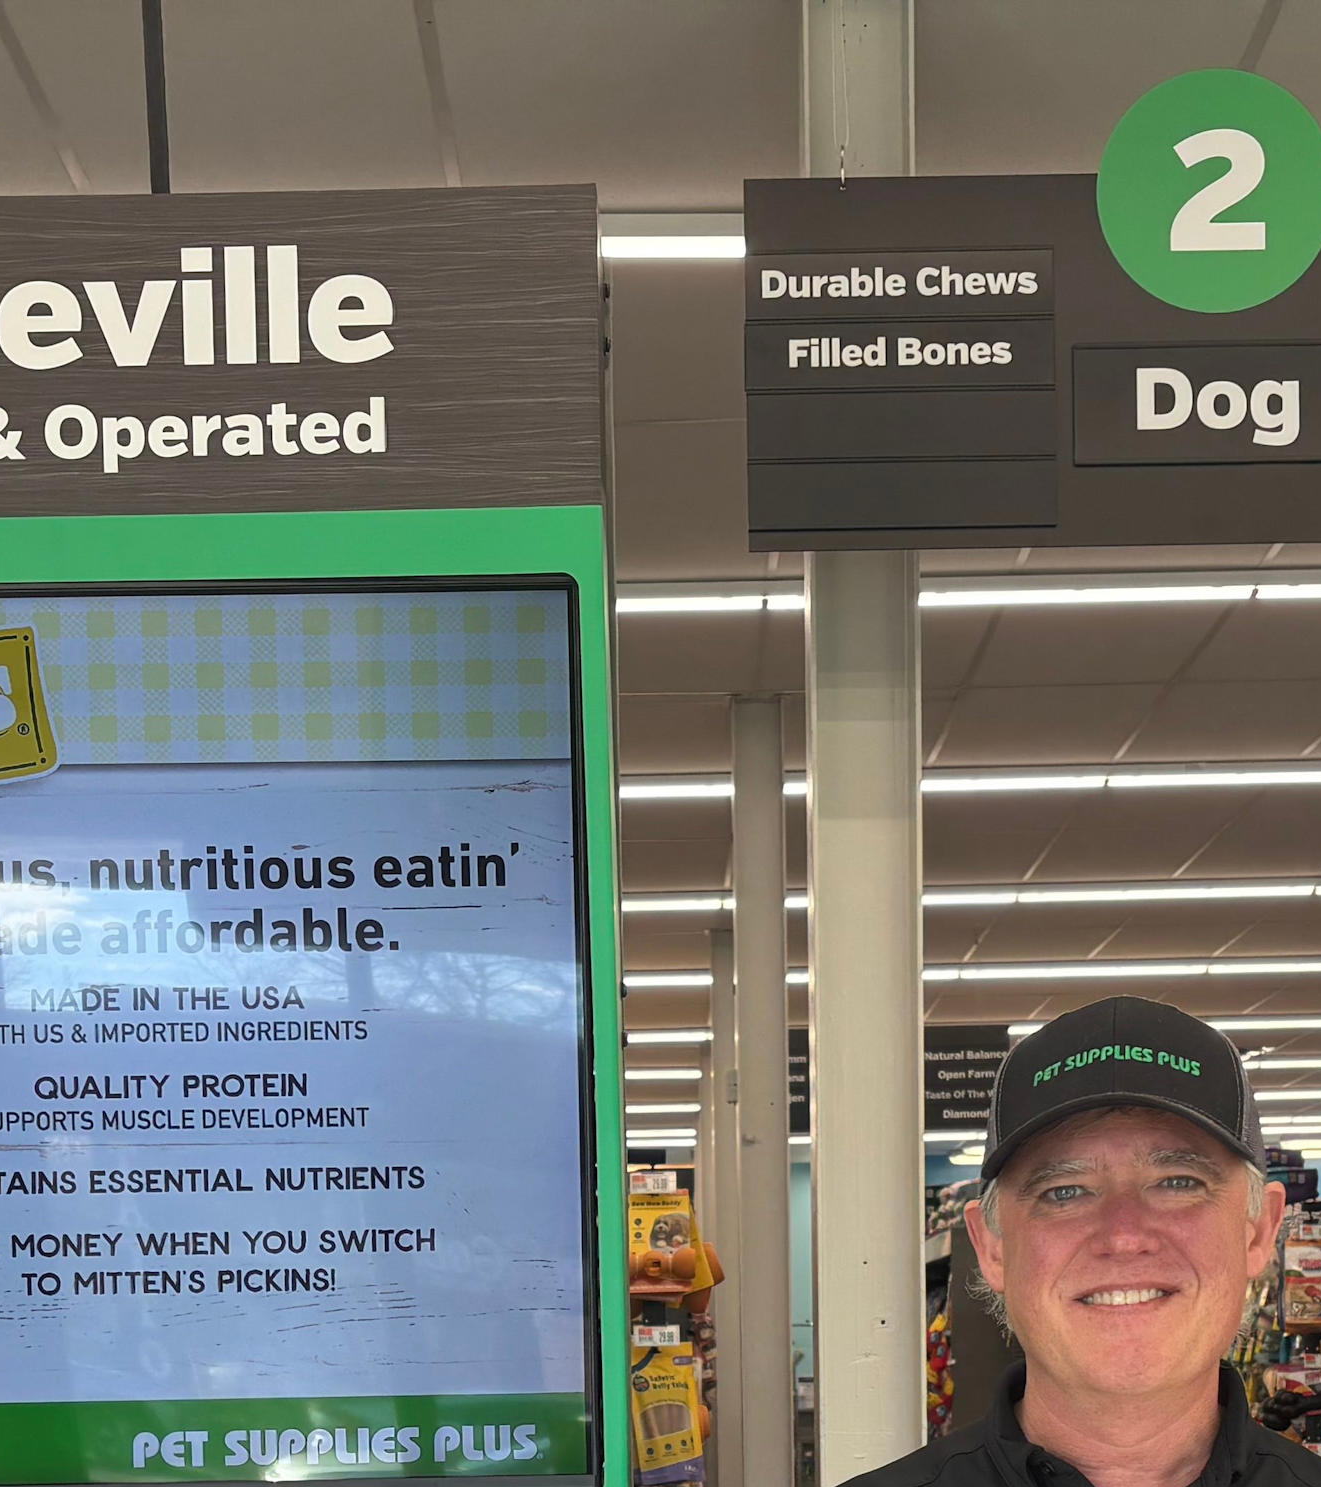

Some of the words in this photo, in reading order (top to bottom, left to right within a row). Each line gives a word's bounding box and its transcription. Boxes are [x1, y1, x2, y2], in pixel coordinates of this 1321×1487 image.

[1170, 128, 1266, 252] 2
[760, 267, 906, 300] Durable
[916, 267, 1038, 298] Chews
[788, 338, 887, 369] Filled
[898, 337, 1013, 367] Bones
[1136, 368, 1302, 446] Dog
[45, 397, 387, 473] Operated
[90, 846, 357, 890] nutritious
[373, 842, 519, 888] eatin'
[101, 908, 399, 955] affordable.
[32, 987, 119, 1013] MADE
[133, 988, 160, 1012] IN
[174, 987, 229, 1011] THE
[242, 986, 304, 1010] USA
[925, 1051, 964, 1060] Natural
[1033, 1062, 1062, 1087] PET
[1065, 1045, 1153, 1072] SUPPLIES
[1157, 1051, 1201, 1077] PLUS
[34, 1075, 169, 1101] QUALITY
[183, 1074, 308, 1099] PROTEIN
[938, 1071, 965, 1080] Open
[968, 1070, 995, 1078] Farm
[943, 1109, 990, 1119] Diamond
[89, 1168, 253, 1194] ESSENTIAL
[265, 1166, 426, 1192] NUTRIENTS
[10, 1233, 123, 1259] MONEY
[136, 1231, 232, 1257] WHEN
[242, 1230, 307, 1255] YOU
[319, 1229, 436, 1254] SWITCH
[22, 1273, 60, 1296] TO
[73, 1270, 205, 1295] MITTEN'S
[217, 1268, 336, 1294] PICKINS!
[132, 1430, 208, 1468] PET
[225, 1427, 420, 1467] SUPPLIES
[434, 1425, 538, 1462] PLUS
